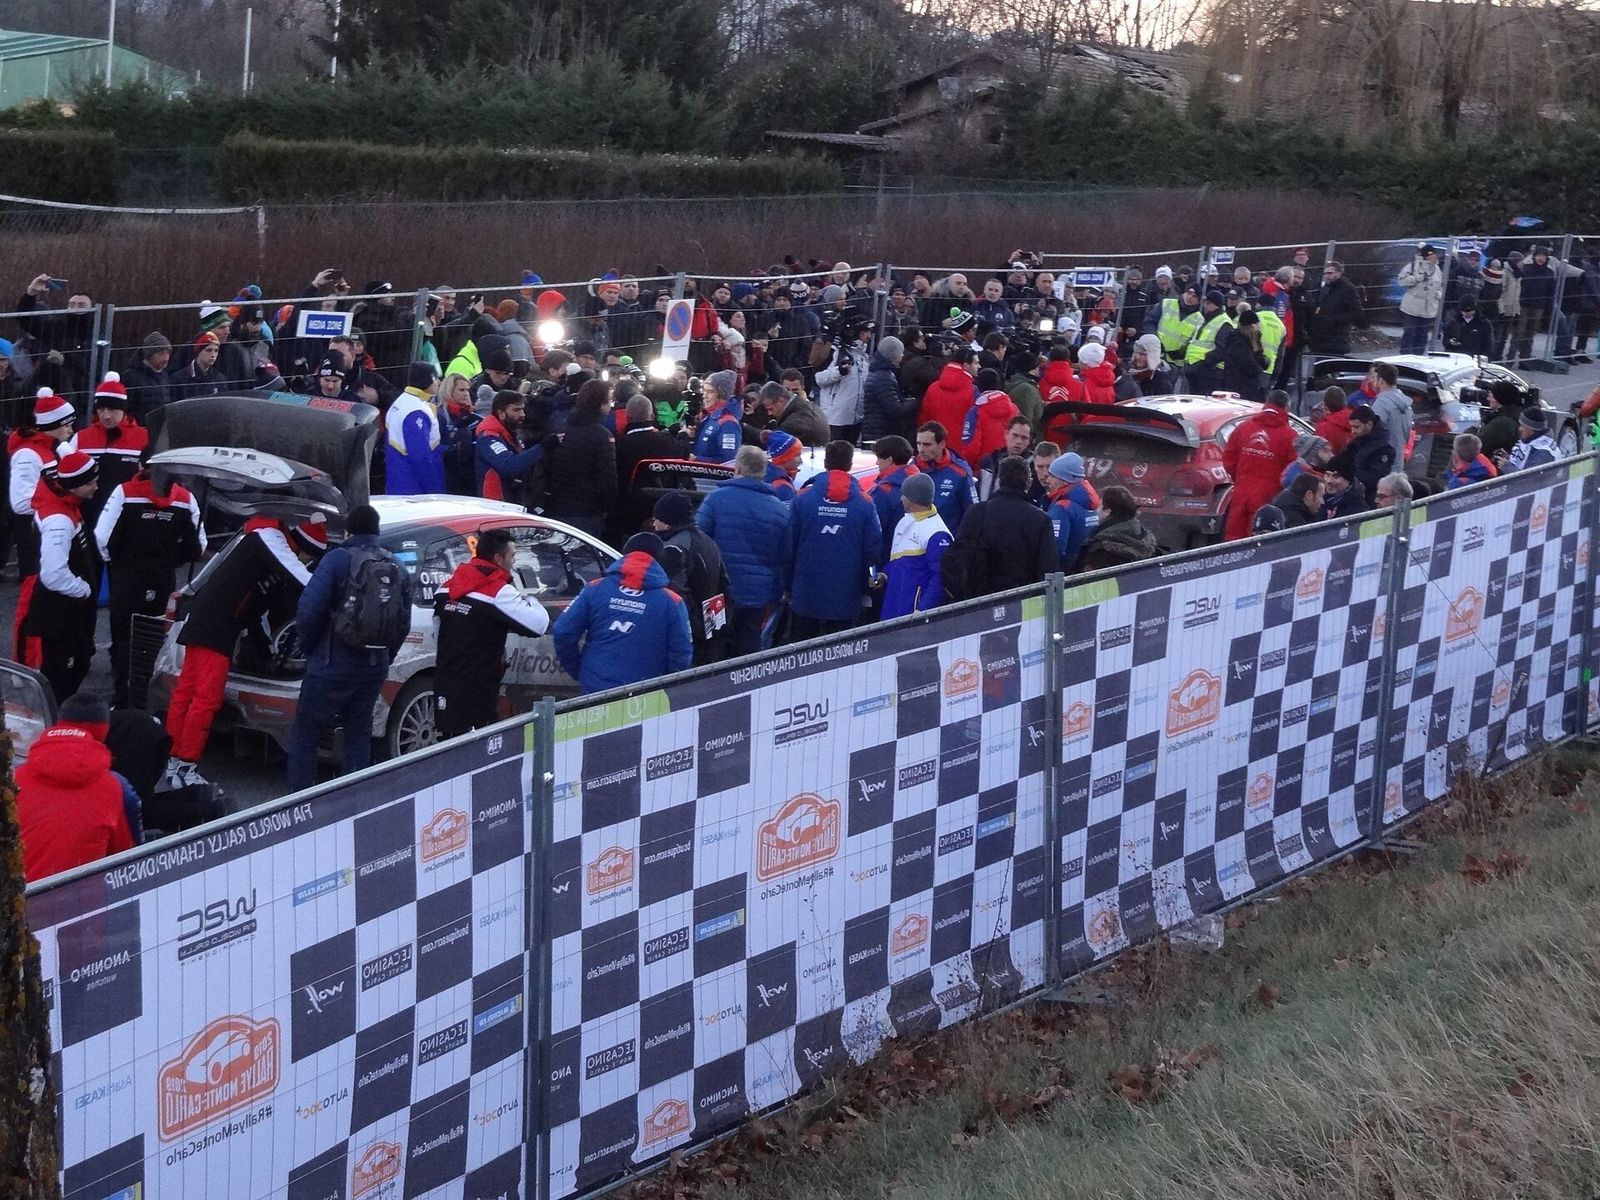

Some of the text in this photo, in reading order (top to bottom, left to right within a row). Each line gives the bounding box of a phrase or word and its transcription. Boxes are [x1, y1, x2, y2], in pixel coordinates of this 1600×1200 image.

[308, 319, 343, 331] MEDIA ZONE
[1086, 457, 1113, 479] 19
[610, 597, 647, 610] HYUNDAI
